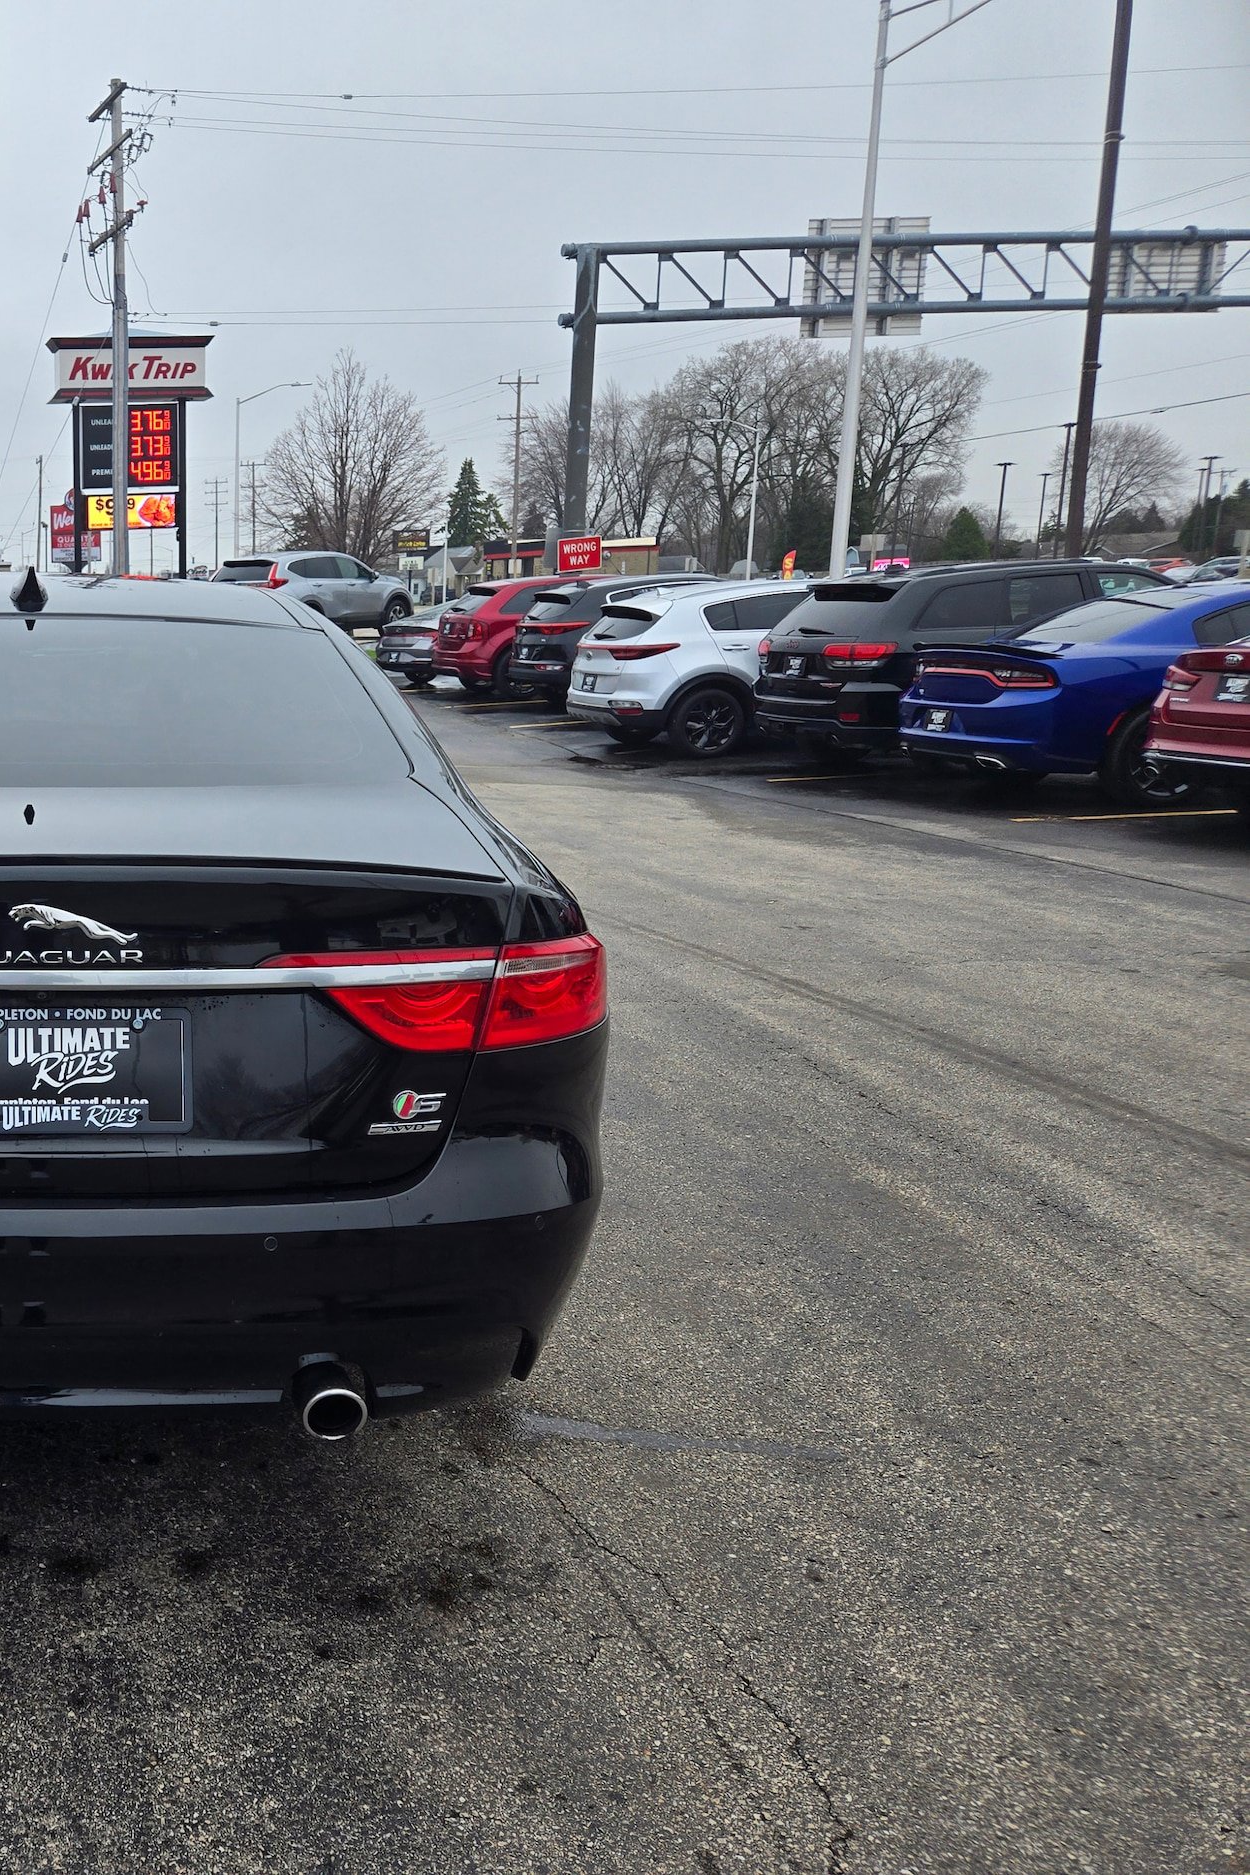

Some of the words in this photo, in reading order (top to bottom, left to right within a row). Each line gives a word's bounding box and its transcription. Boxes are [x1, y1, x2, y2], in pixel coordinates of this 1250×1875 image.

[68, 356, 139, 380] KWK
[142, 355, 197, 380] TRIP
[90, 418, 114, 426] UNLEA
[57, 535, 95, 543] QUAITY
[563, 541, 597, 554] WRONG
[569, 554, 590, 566] WAY
[66, 1008, 107, 1020] FOND
[111, 1008, 132, 1020] DU
[135, 1008, 162, 1020] LAC
[7, 1027, 131, 1067] ULTIMATE
[2, 1105, 81, 1131] ULTIMATE
